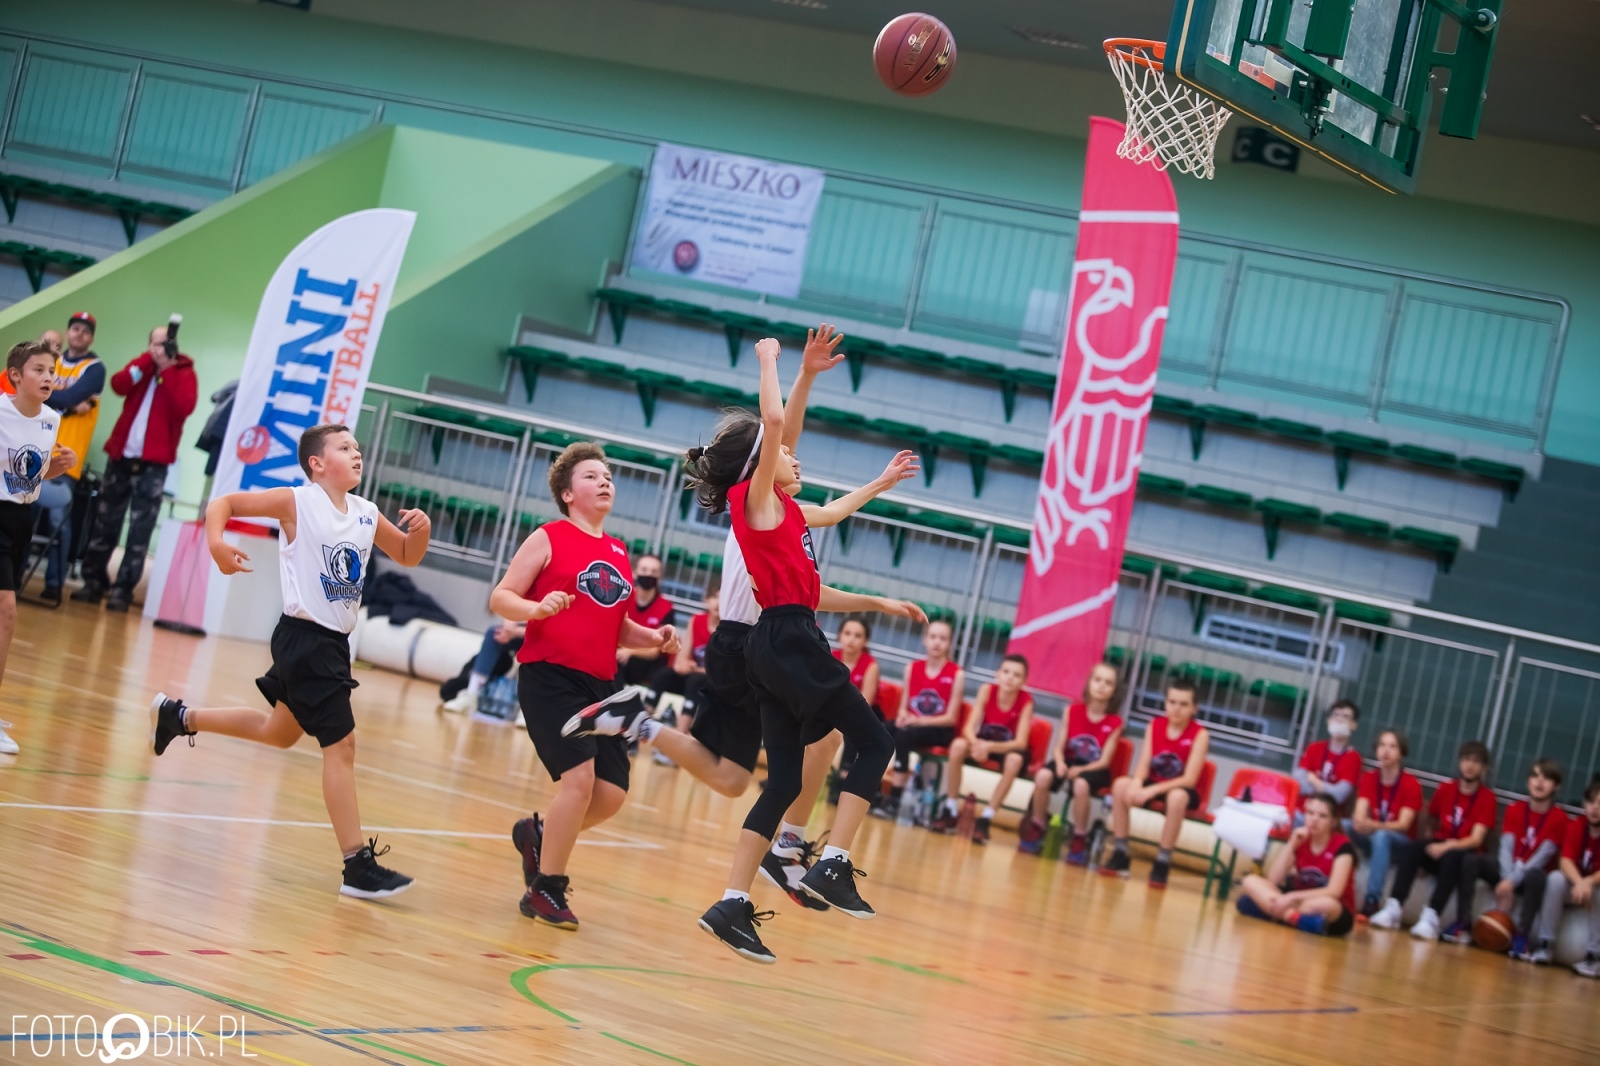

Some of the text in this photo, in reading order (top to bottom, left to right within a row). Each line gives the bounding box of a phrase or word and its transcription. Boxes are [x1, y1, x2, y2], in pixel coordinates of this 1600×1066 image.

[670, 156, 802, 200] MIESZKO
[1263, 141, 1293, 167] C
[239, 267, 358, 490] MINI
[322, 282, 381, 425] KETBALL
